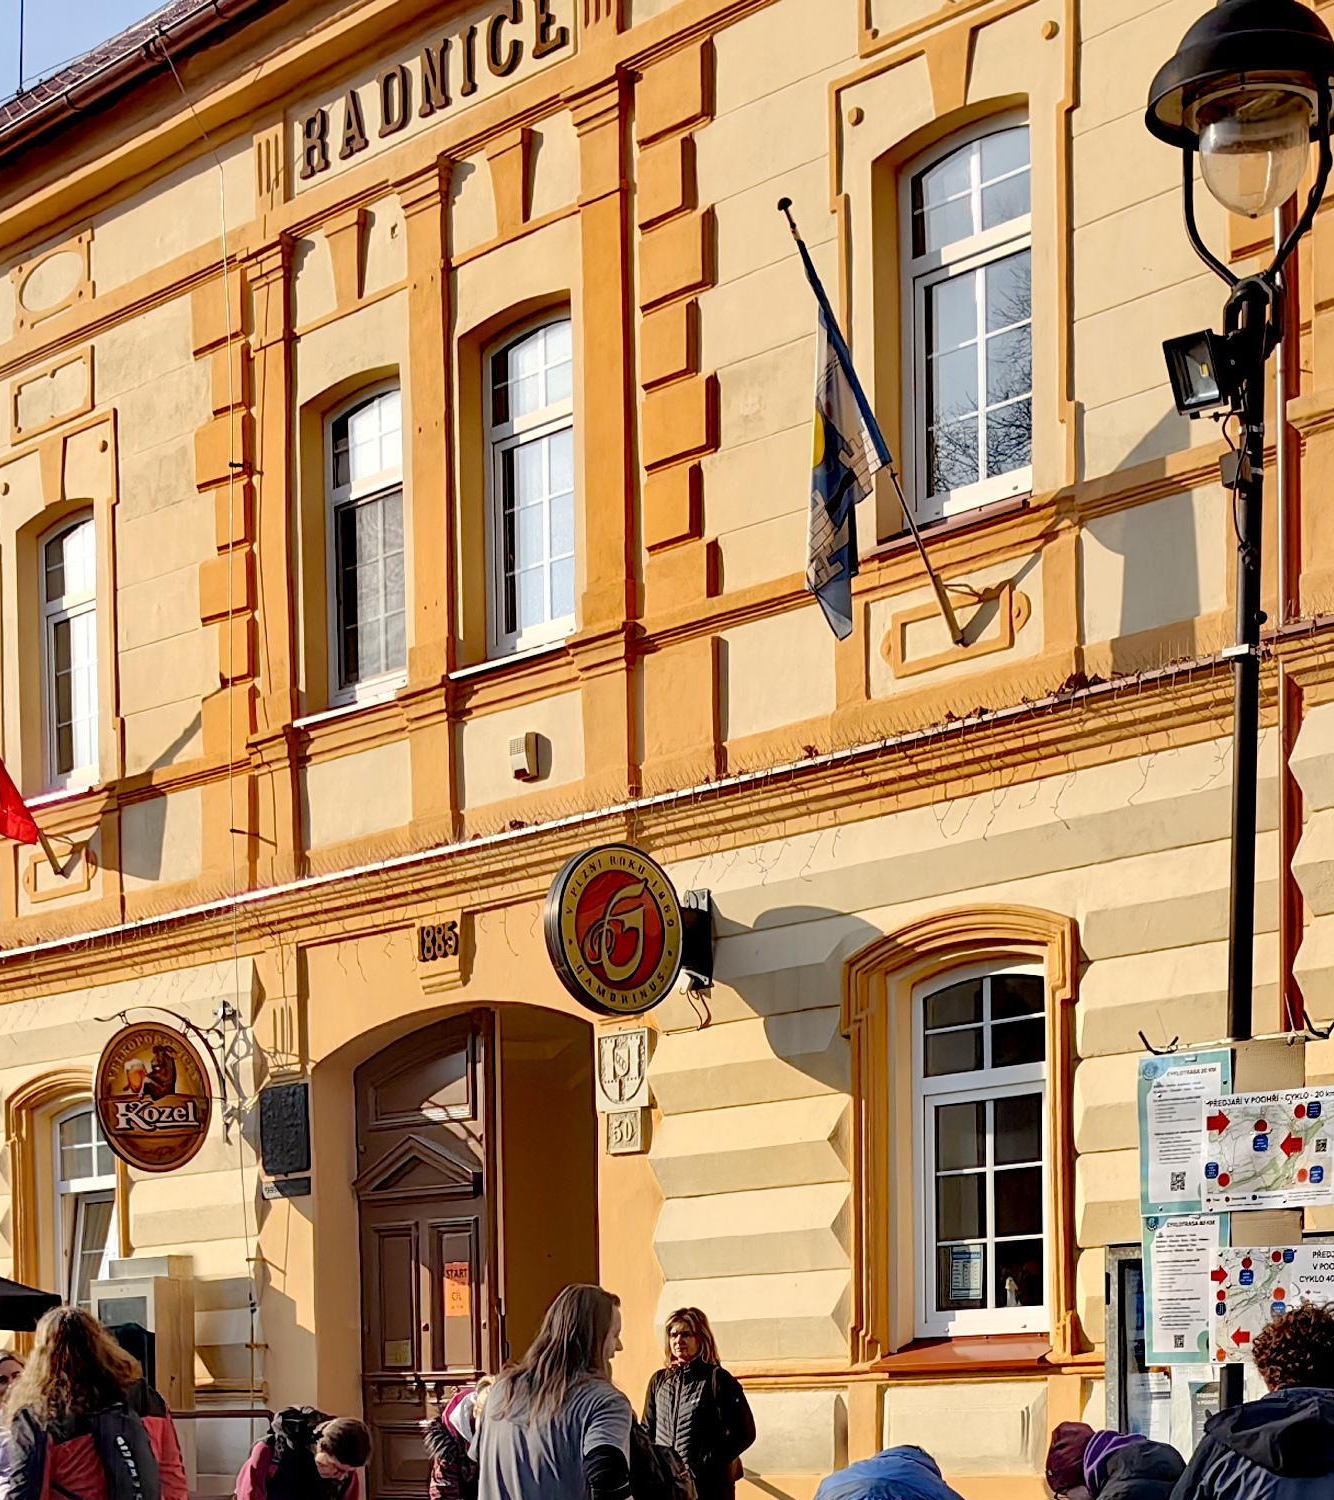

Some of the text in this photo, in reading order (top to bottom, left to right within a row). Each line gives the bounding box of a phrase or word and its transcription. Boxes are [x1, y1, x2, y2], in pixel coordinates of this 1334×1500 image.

[300, 0, 569, 180] RADNICE
[417, 920, 459, 962] 1885
[114, 1101, 199, 1130] Kozel
[613, 1120, 635, 1144] 50
[1299, 1275, 1325, 1283] CYKLO
